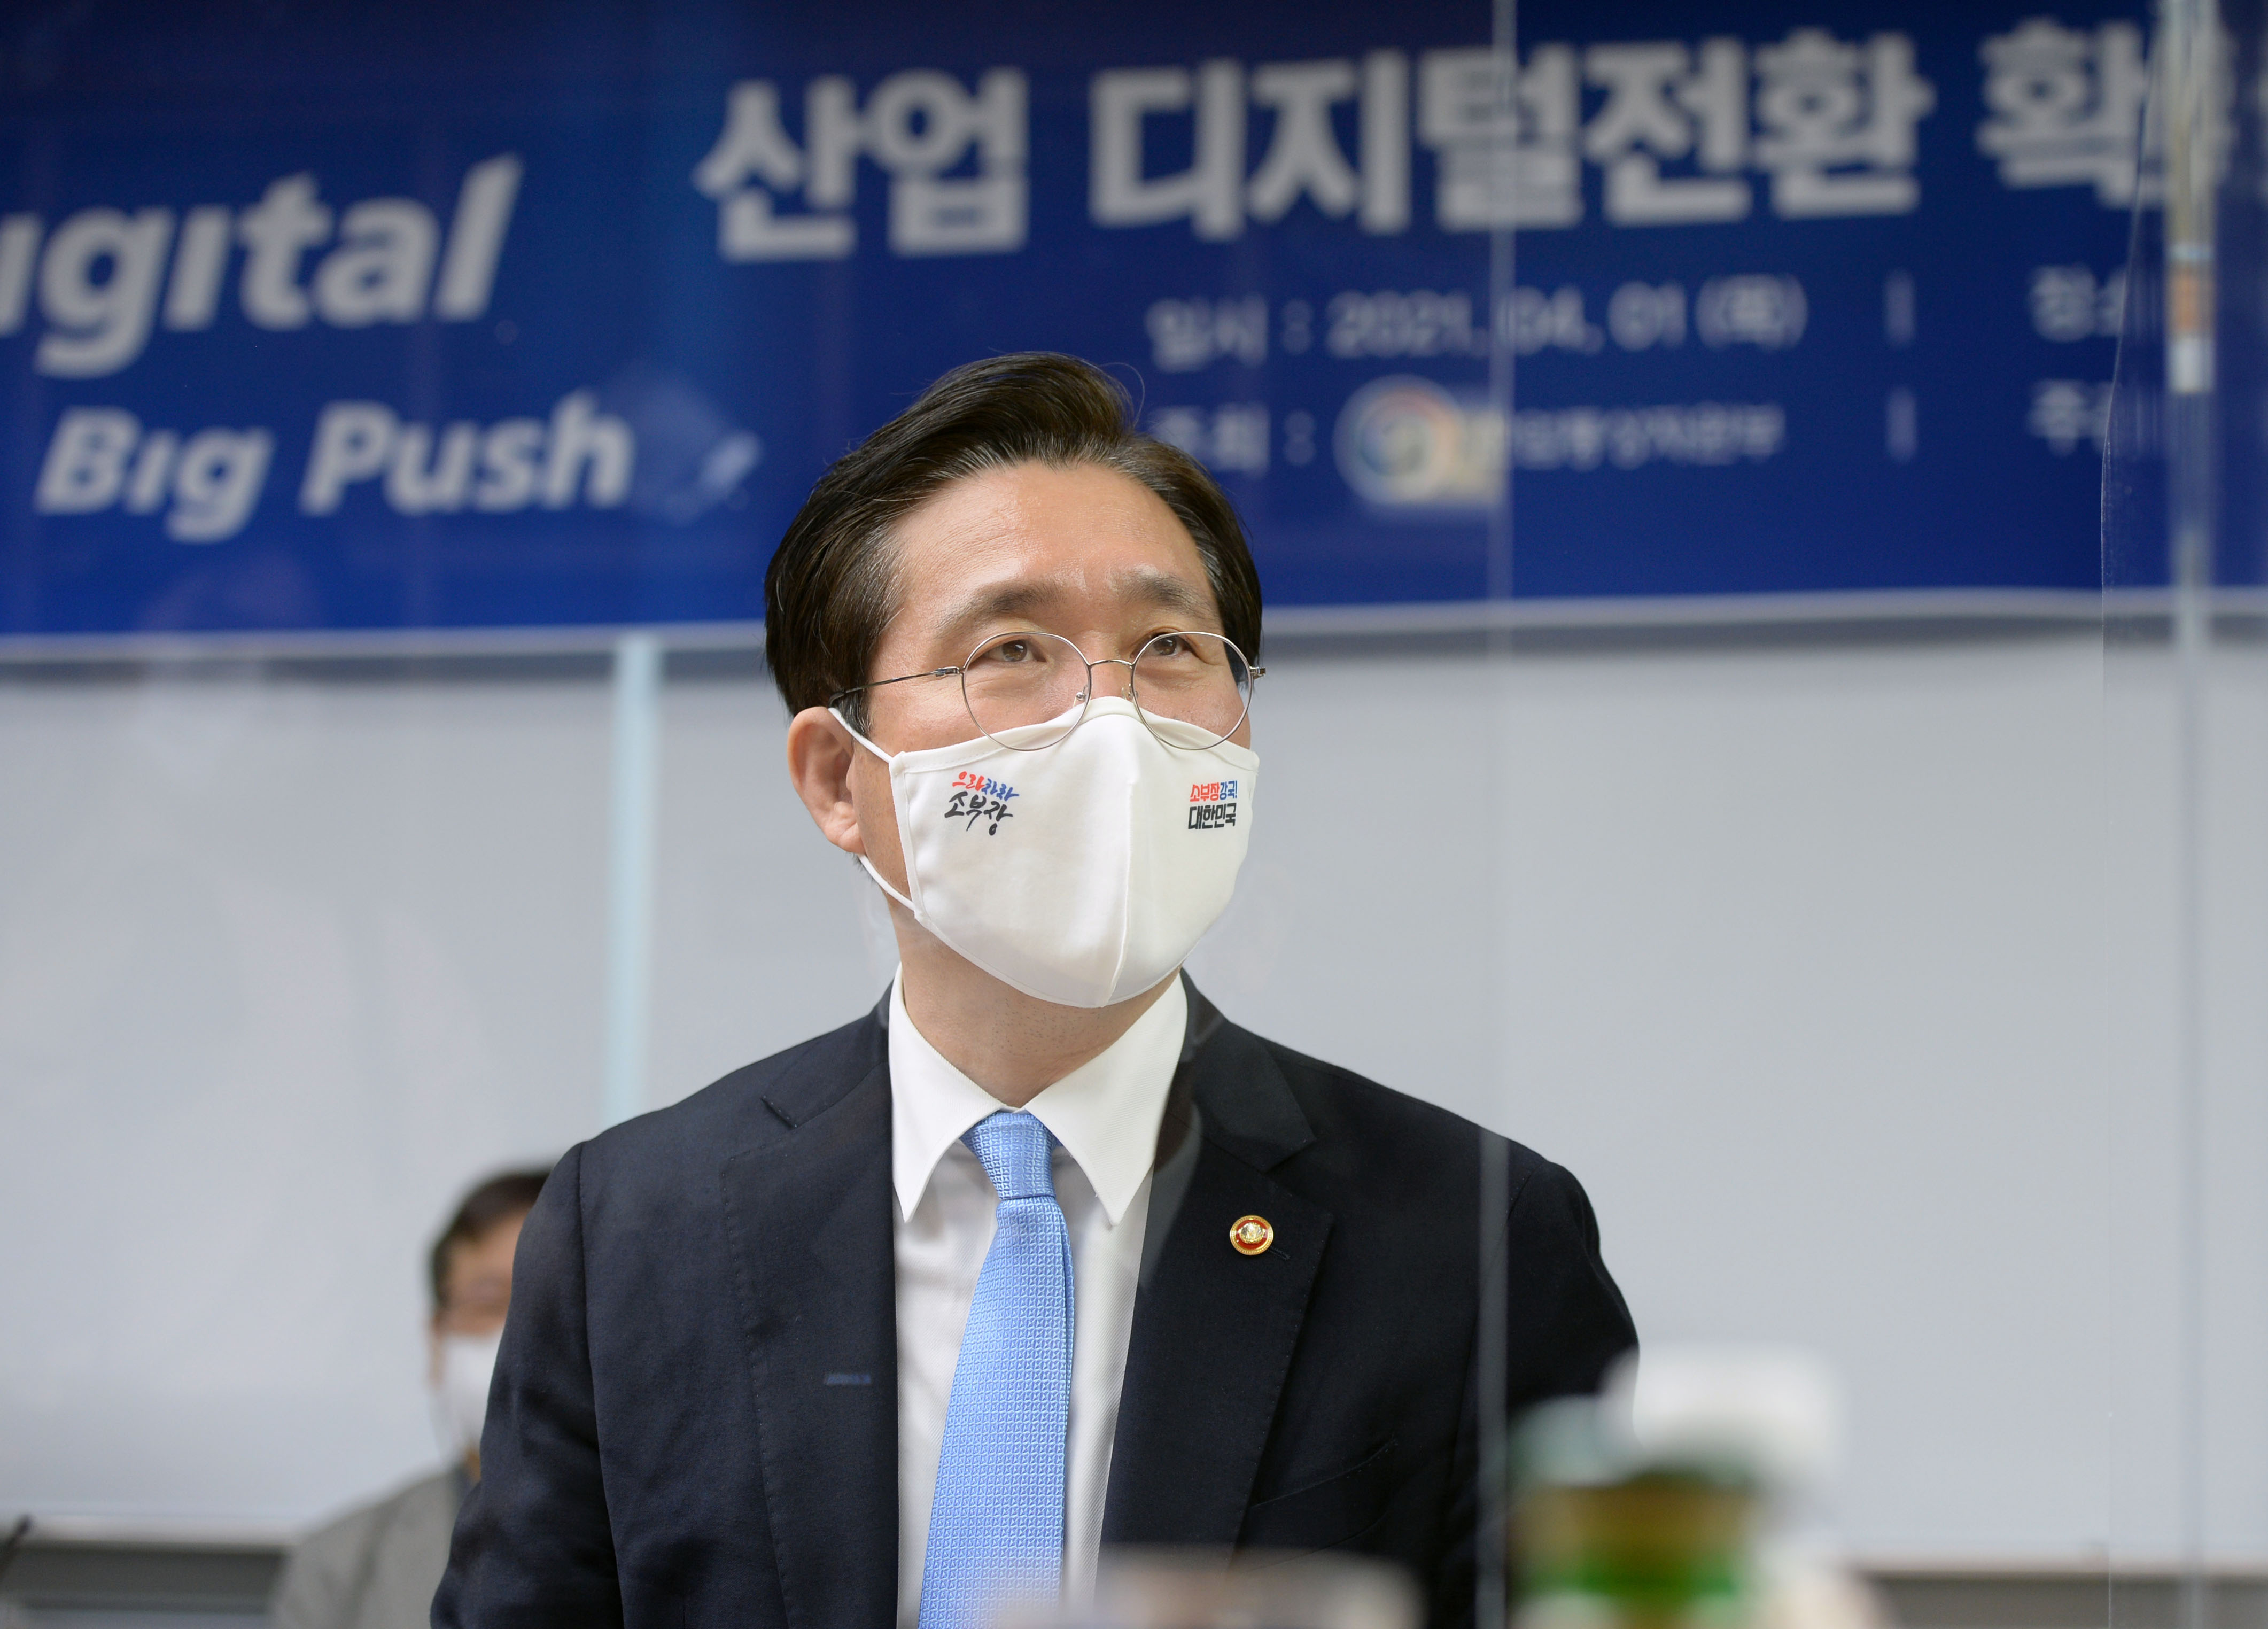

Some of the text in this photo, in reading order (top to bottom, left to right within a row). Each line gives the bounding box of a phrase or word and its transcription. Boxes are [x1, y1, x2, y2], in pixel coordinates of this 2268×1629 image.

[696, 69, 1026, 261] 산업
[1091, 31, 1932, 239] 디지털전환
[36, 393, 635, 541] Big Push
[944, 791, 1013, 836] 소부장
[1188, 802, 1237, 829] 대한민국
